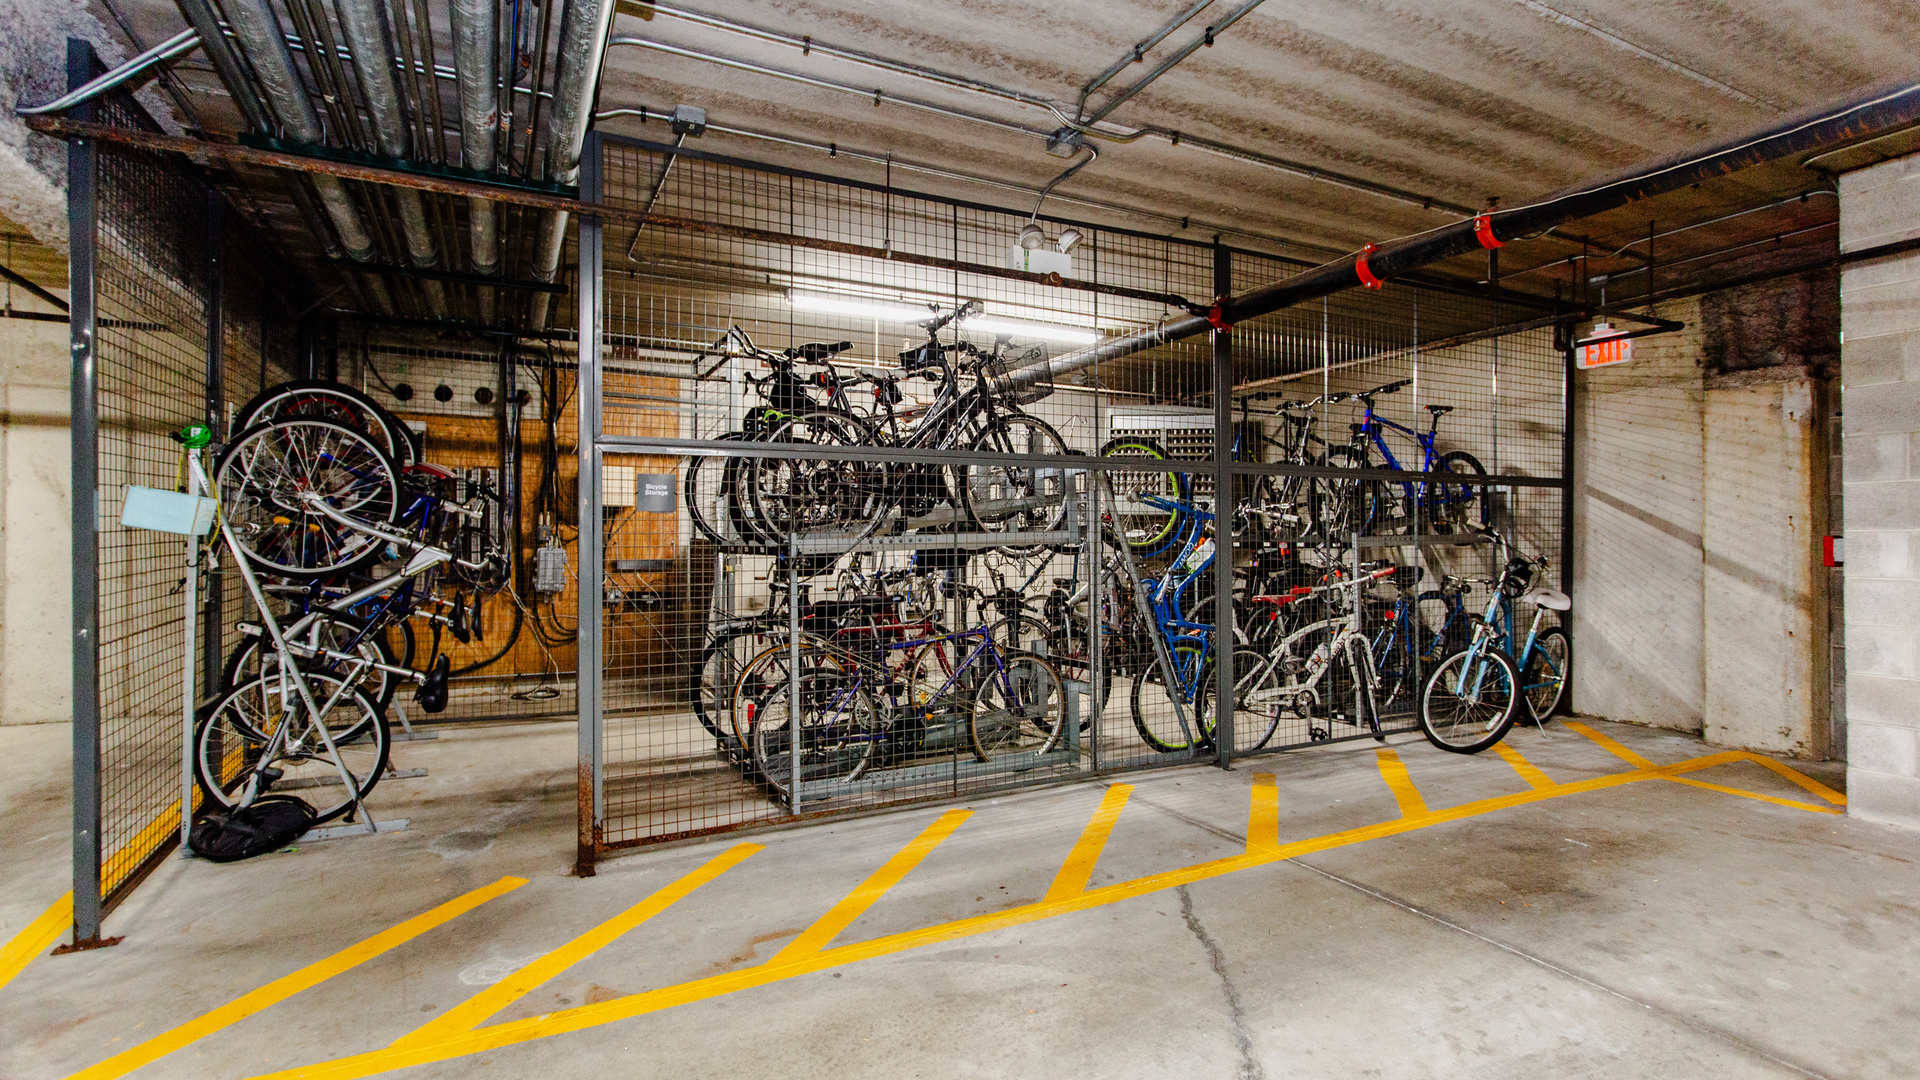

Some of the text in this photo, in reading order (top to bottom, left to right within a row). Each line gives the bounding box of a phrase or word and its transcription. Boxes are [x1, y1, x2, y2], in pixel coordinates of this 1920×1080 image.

[1585, 338, 1622, 366] EXIT
[645, 483, 668, 491] Bicycle
[644, 489, 669, 497] Storage
